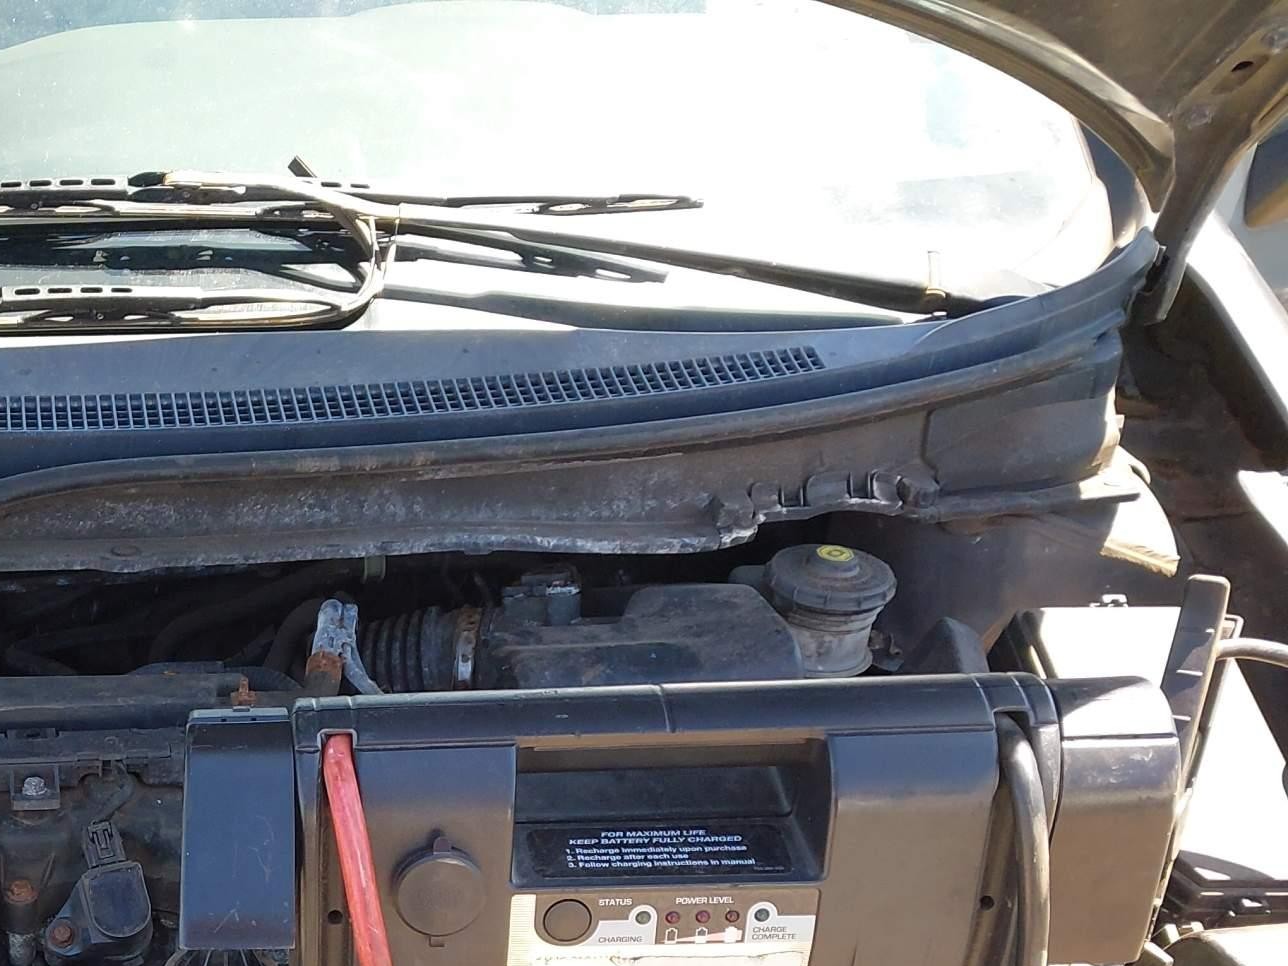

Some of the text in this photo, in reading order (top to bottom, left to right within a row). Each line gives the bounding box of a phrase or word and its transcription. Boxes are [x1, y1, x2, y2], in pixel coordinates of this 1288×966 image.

[601, 837, 650, 845] BATTERY
[687, 835, 743, 843] CHARGED
[576, 848, 620, 856] Recharge
[704, 844, 748, 853] purchase
[577, 854, 621, 862] Recharge
[611, 860, 653, 869] charging
[721, 858, 756, 866] manual
[598, 898, 633, 906] STATUS
[675, 896, 734, 905] POWER LEVEL
[598, 936, 643, 944] CHARGING
[751, 933, 797, 941] COMPLETE
